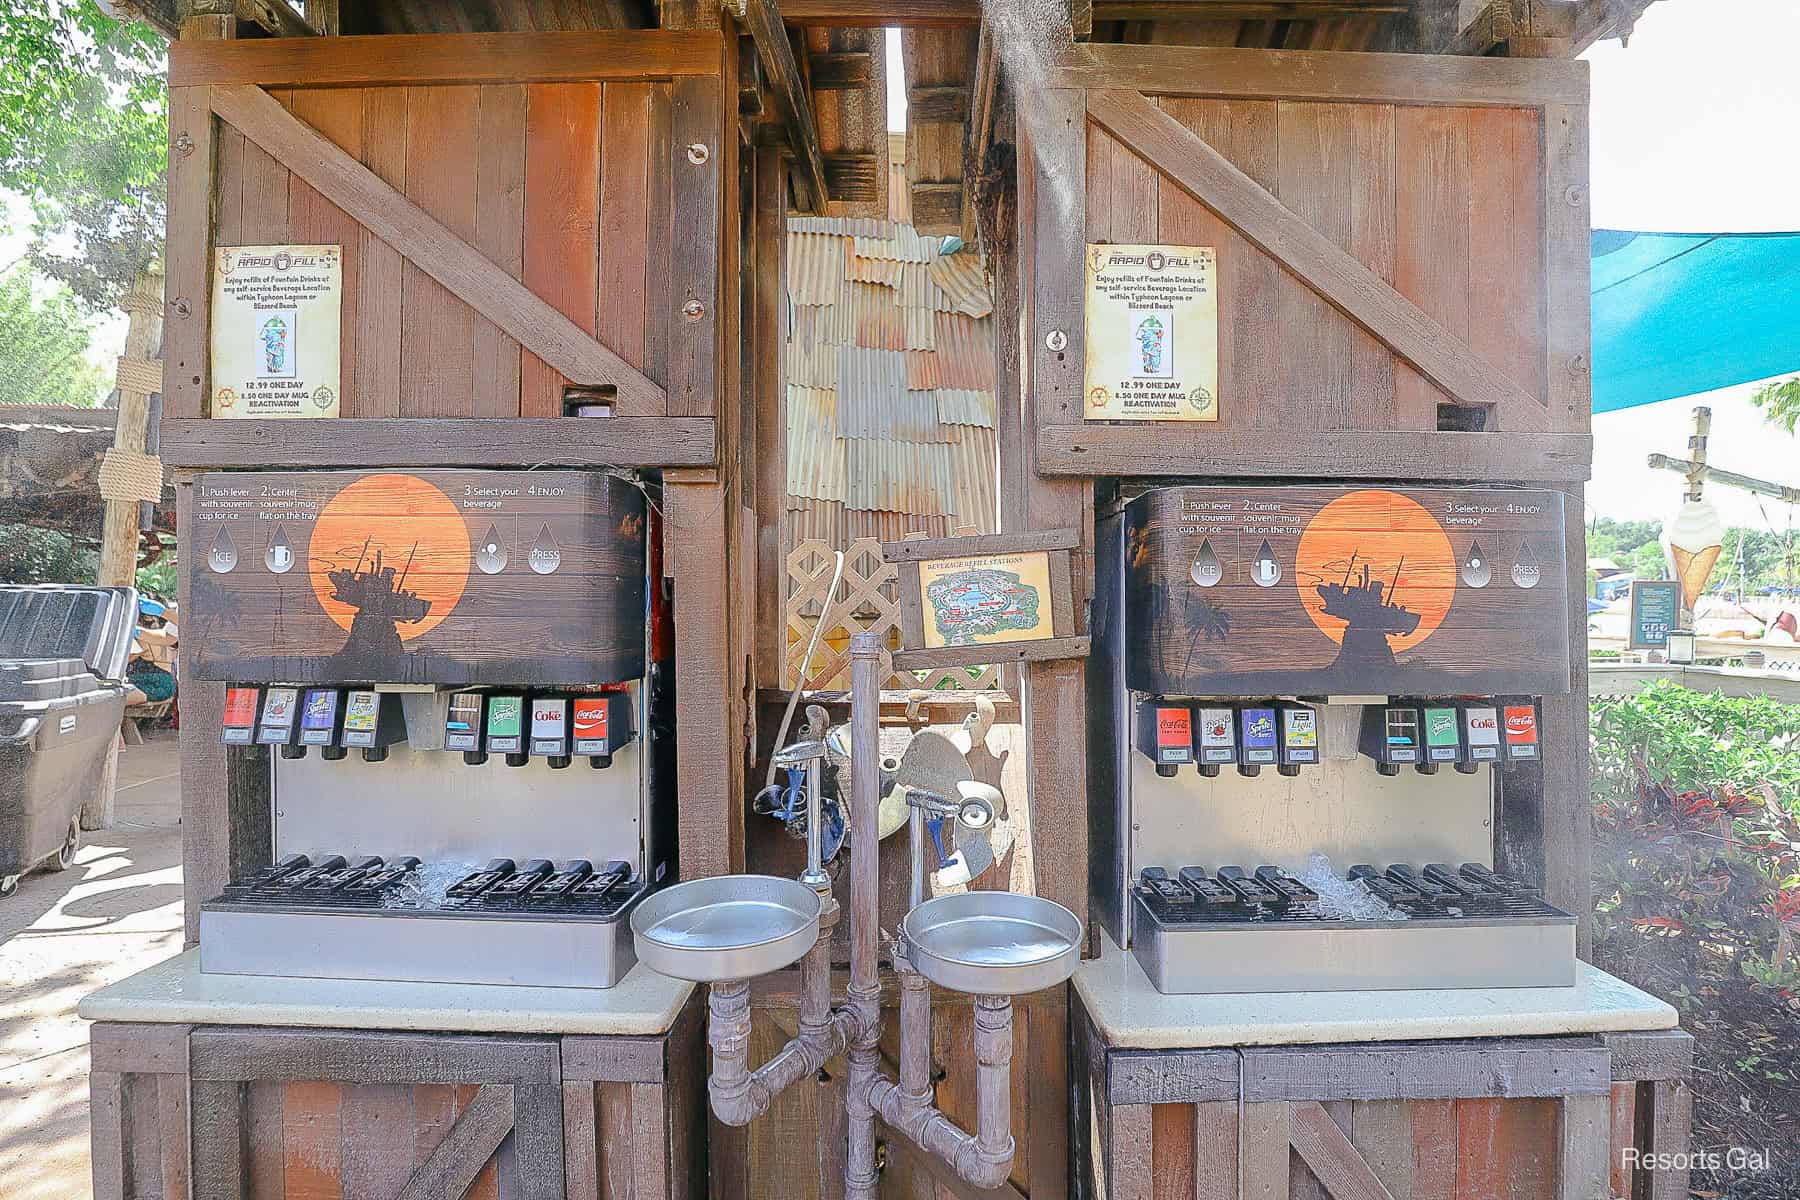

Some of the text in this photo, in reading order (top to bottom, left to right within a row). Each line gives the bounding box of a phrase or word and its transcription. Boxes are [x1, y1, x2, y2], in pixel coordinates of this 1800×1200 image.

[238, 258, 316, 266] RAPID FILL
[1109, 257, 1190, 266] RAPID FILL
[225, 276, 242, 285] Enjoy
[1096, 275, 1115, 284] Enjoy
[272, 285, 302, 293] Beverage
[1147, 285, 1177, 293] Beverage
[1178, 285, 1206, 293] Location
[257, 294, 284, 302] Typhoon
[284, 294, 307, 302] Lagoon
[1131, 293, 1159, 302] Typhoon
[1160, 294, 1184, 302] Lagoon
[1124, 400, 1176, 408] REACTIVATION
[210, 488, 228, 496] Push
[229, 488, 249, 496] lever
[271, 488, 298, 496] Center
[473, 487, 499, 496] Select
[500, 489, 519, 498] your
[537, 487, 565, 496] ENJOY
[200, 500, 253, 508] with souvenir
[260, 500, 316, 510] souvenir mug
[463, 499, 502, 509] beverage
[1190, 502, 1210, 510] Push
[1211, 502, 1232, 510] lever
[1254, 503, 1281, 511] Center
[1455, 504, 1479, 513] Select
[1480, 506, 1499, 515] your
[1515, 506, 1541, 514] ENJOY
[214, 512, 227, 520] for
[227, 512, 239, 520] ice
[260, 512, 273, 520] flat
[286, 512, 301, 520] the
[301, 513, 316, 521] tray
[1182, 513, 1200, 521] with
[1243, 514, 1301, 524] souvenir mug
[1446, 516, 1482, 526] beverage
[1179, 527, 1195, 535] cup
[1270, 526, 1285, 534] the
[1286, 527, 1302, 536] tray
[215, 552, 232, 562] ICE
[531, 551, 560, 560] PRESS
[1200, 565, 1217, 576] ICE
[1513, 565, 1539, 575] PRESS
[534, 711, 561, 721] Coke
[576, 709, 604, 720] Coca-Cola
[1159, 719, 1188, 729] Coca-Cola
[1290, 719, 1312, 731] Light
[1471, 719, 1497, 729] Coke
[1507, 716, 1535, 726] Coca-Cola
